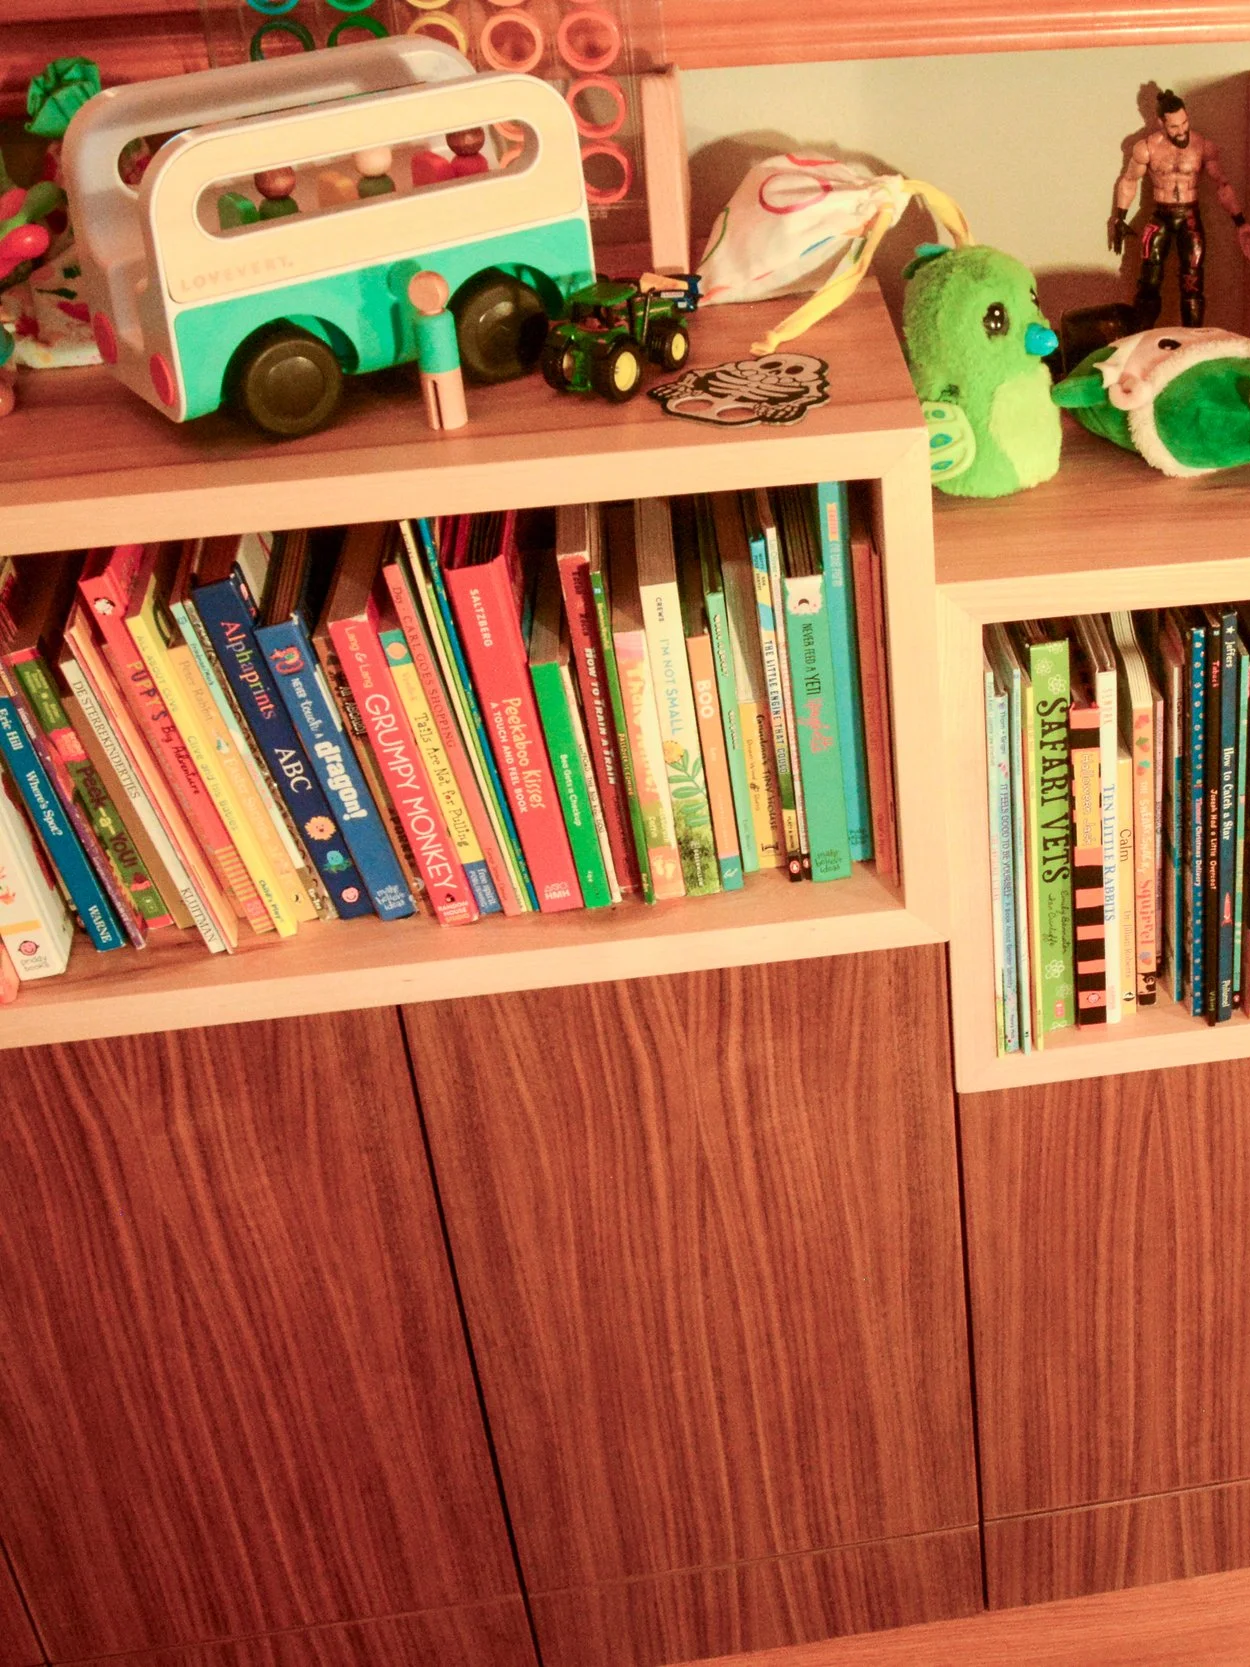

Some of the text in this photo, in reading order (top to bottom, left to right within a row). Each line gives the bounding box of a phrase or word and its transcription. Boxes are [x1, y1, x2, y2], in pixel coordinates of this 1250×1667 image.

[469, 588, 493, 648] SALTZBERG
[655, 596, 665, 622] CREWS
[801, 623, 814, 648] NEVER
[1224, 641, 1237, 668] Jeffers
[221, 621, 277, 721] Alphaprints
[804, 648, 816, 665] FEED
[402, 615, 456, 749] CARL GOES SHOPPING
[659, 639, 684, 735] I'M NOT SMALL
[696, 679, 715, 719] BOO
[806, 674, 821, 696] YETI
[584, 647, 616, 785] HOW TO TRAIN TRAIN
[763, 640, 789, 775] THE LITTLE ENGINE THAT COULD
[0, 707, 14, 730] Eric
[7, 729, 24, 752] Hill
[71, 679, 141, 801] DE STERREKINDERTJES
[126, 662, 201, 795] PUPPY'S Big Adventure
[187, 735, 204, 761] Clive
[200, 764, 216, 782] and
[290, 677, 368, 822] NEVER touch dragon!
[344, 626, 458, 889] Lang & Lang GRUMPY MONKEY
[493, 711, 528, 814] TOUCH AND FEEL BOOK
[501, 697, 546, 810] Peekaboo Kisses
[1223, 747, 1235, 768] How
[274, 748, 313, 794] ABC
[414, 711, 470, 848] Tails Are Not for Pulling
[762, 770, 774, 793] TINY
[1036, 697, 1071, 883] SAFARI VETS
[1223, 770, 1233, 781] to
[25, 770, 64, 837] Where's Spot?
[569, 793, 582, 828] Checkup
[766, 796, 779, 831] HOUSE
[1000, 792, 1009, 812] FEELS
[1080, 753, 1098, 846] Halloween Jack
[1223, 783, 1234, 810] Catch
[1000, 814, 1010, 836] GOOD
[1001, 838, 1010, 849] TO
[1223, 820, 1234, 841] Star
[1001, 850, 1010, 860] BE
[1103, 785, 1116, 922] TEN LITTLE RABBITS
[1119, 829, 1132, 862] Calm
[1138, 781, 1155, 945] THE Squirrel
[1001, 861, 1011, 898] YOURSELF
[1194, 859, 1203, 887] Delivery
[1209, 860, 1218, 890] Overcoat
[437, 901, 469, 912] RANDOM
[544, 890, 571, 900] HMH
[86, 904, 113, 944] WARNE
[179, 887, 217, 944] KLUITMAN
[1221, 979, 1231, 1008] Philomel
